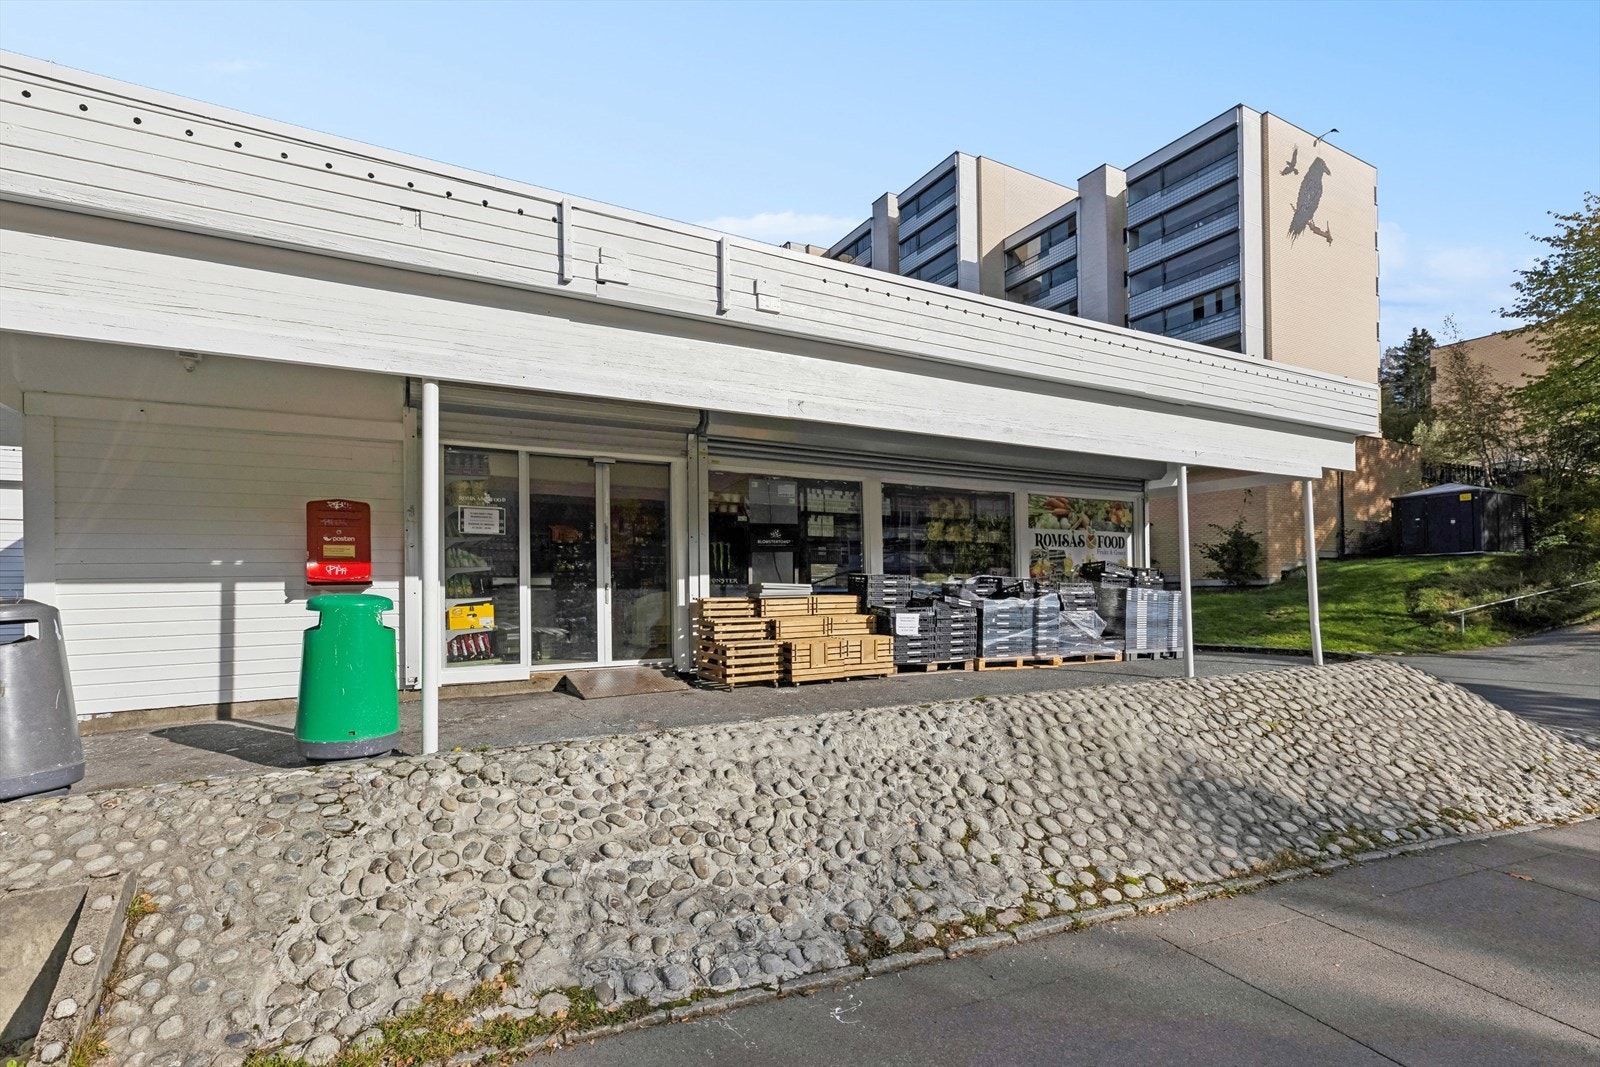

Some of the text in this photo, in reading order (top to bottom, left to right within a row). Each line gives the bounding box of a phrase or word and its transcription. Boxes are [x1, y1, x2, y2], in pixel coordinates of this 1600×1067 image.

[1035, 530, 1125, 550] ROMSÅS FOOD
[711, 577, 738, 585] ONSTER
